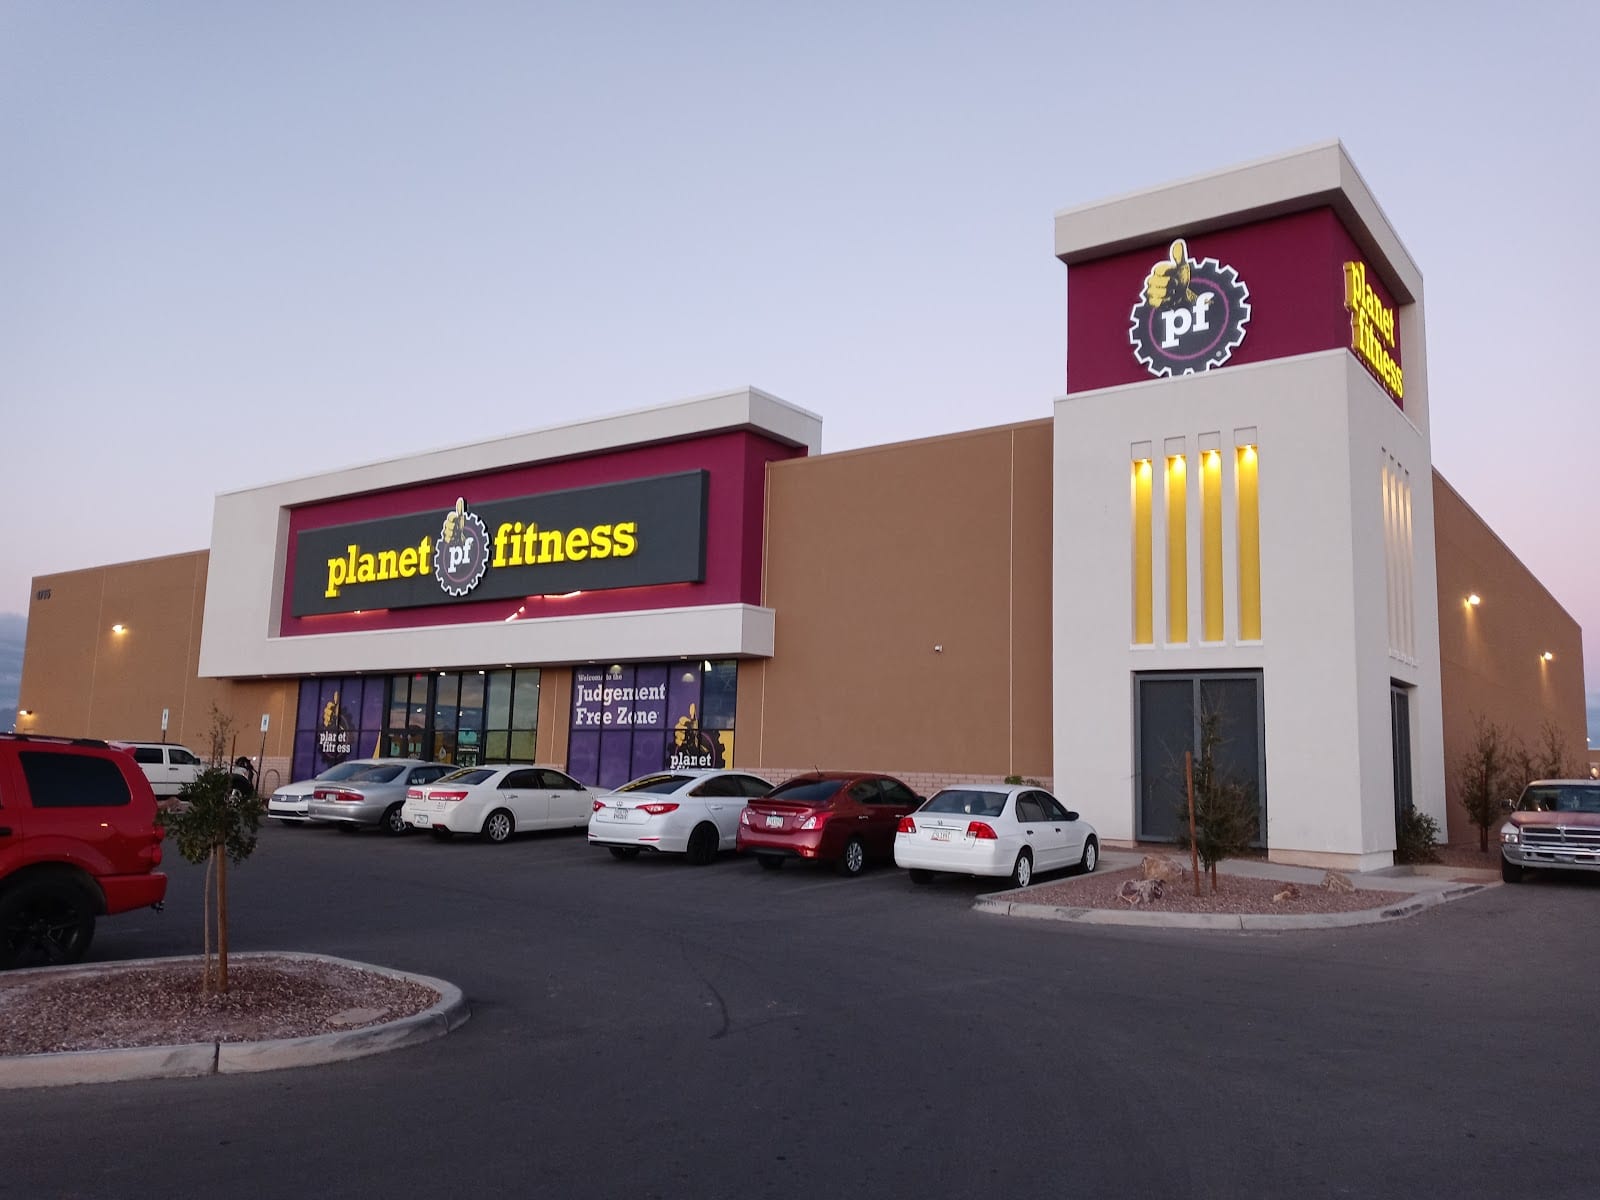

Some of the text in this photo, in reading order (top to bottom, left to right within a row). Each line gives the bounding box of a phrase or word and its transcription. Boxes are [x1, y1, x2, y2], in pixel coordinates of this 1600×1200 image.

[1161, 292, 1214, 348] pf
[1350, 261, 1396, 348] planet
[1358, 306, 1404, 398] fitness
[325, 521, 637, 598] planet pf fitness
[576, 683, 666, 706] Judgement
[606, 673, 612, 681] to
[613, 672, 623, 681] the
[576, 706, 658, 725] Free Zone
[670, 751, 712, 769] planet
